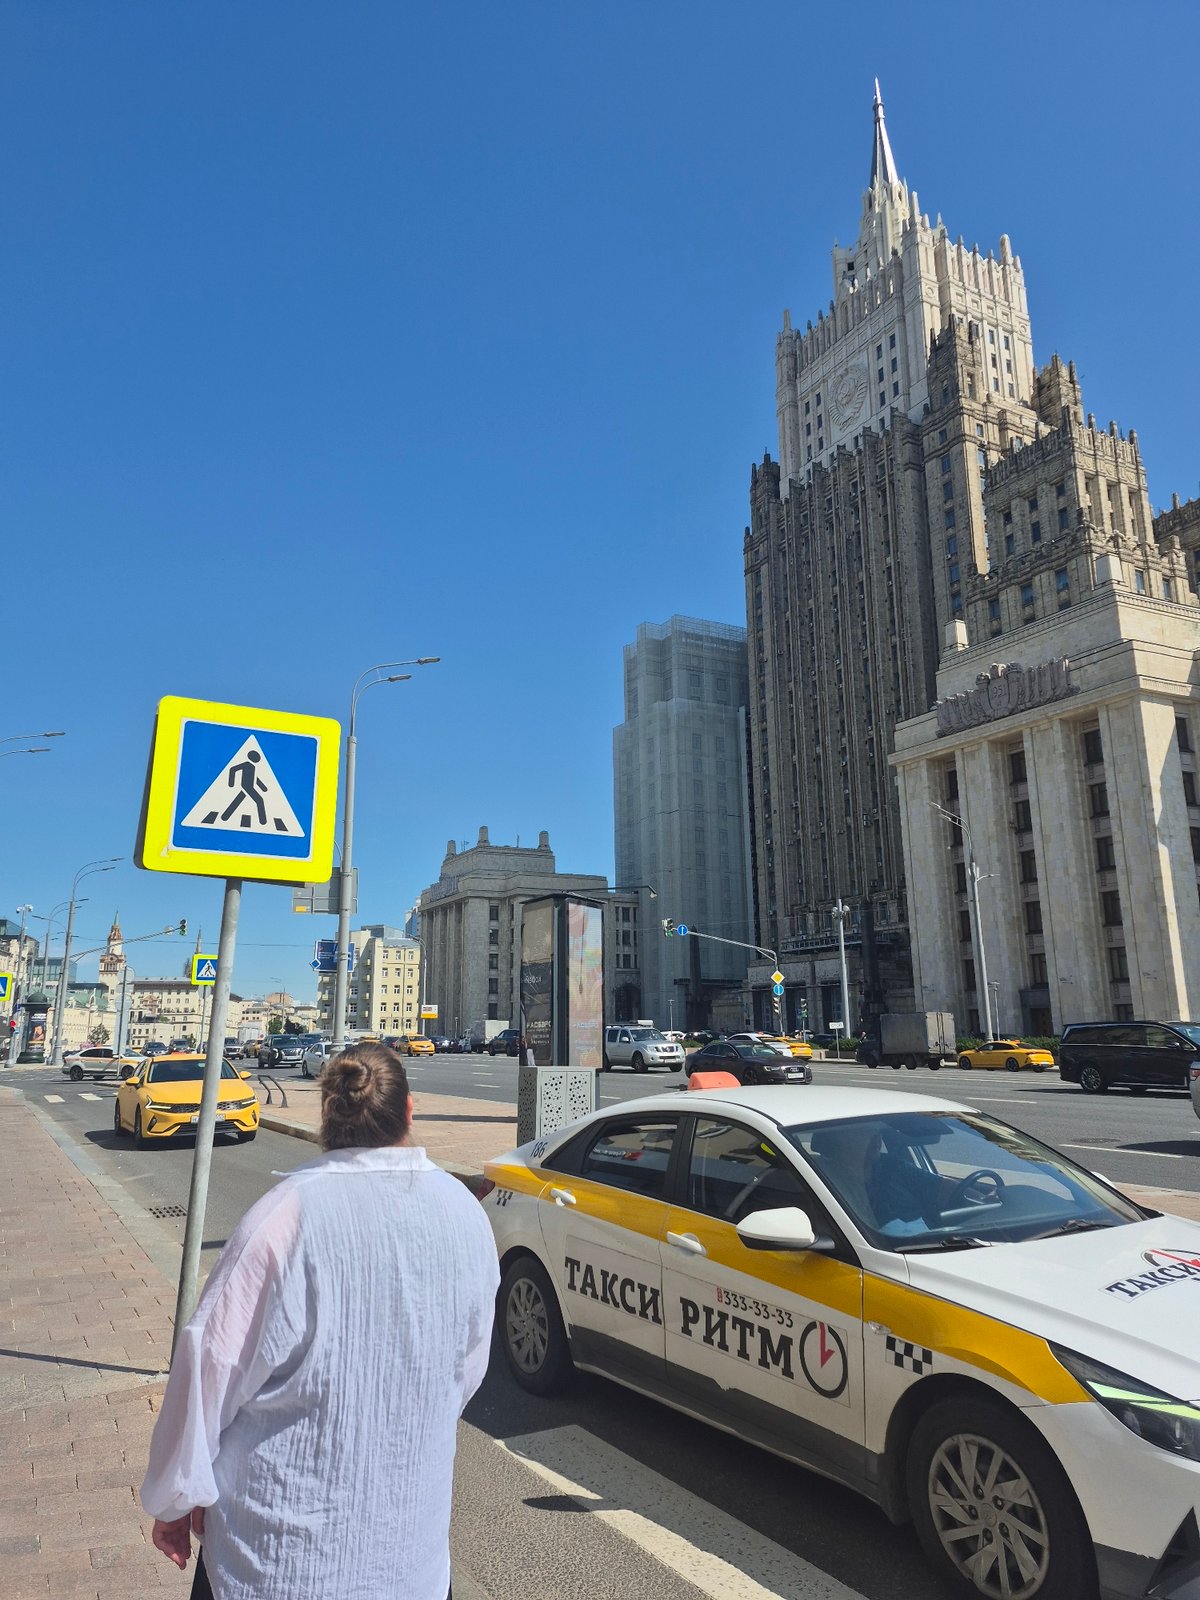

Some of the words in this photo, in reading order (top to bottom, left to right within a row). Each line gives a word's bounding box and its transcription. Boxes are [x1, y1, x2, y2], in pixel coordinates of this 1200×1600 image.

[530, 1141, 548, 1158] 186
[1105, 1262, 1200, 1297] ТАКСИ
[565, 1257, 662, 1325] ТАКСИ
[680, 1297, 794, 1380] РИТМ
